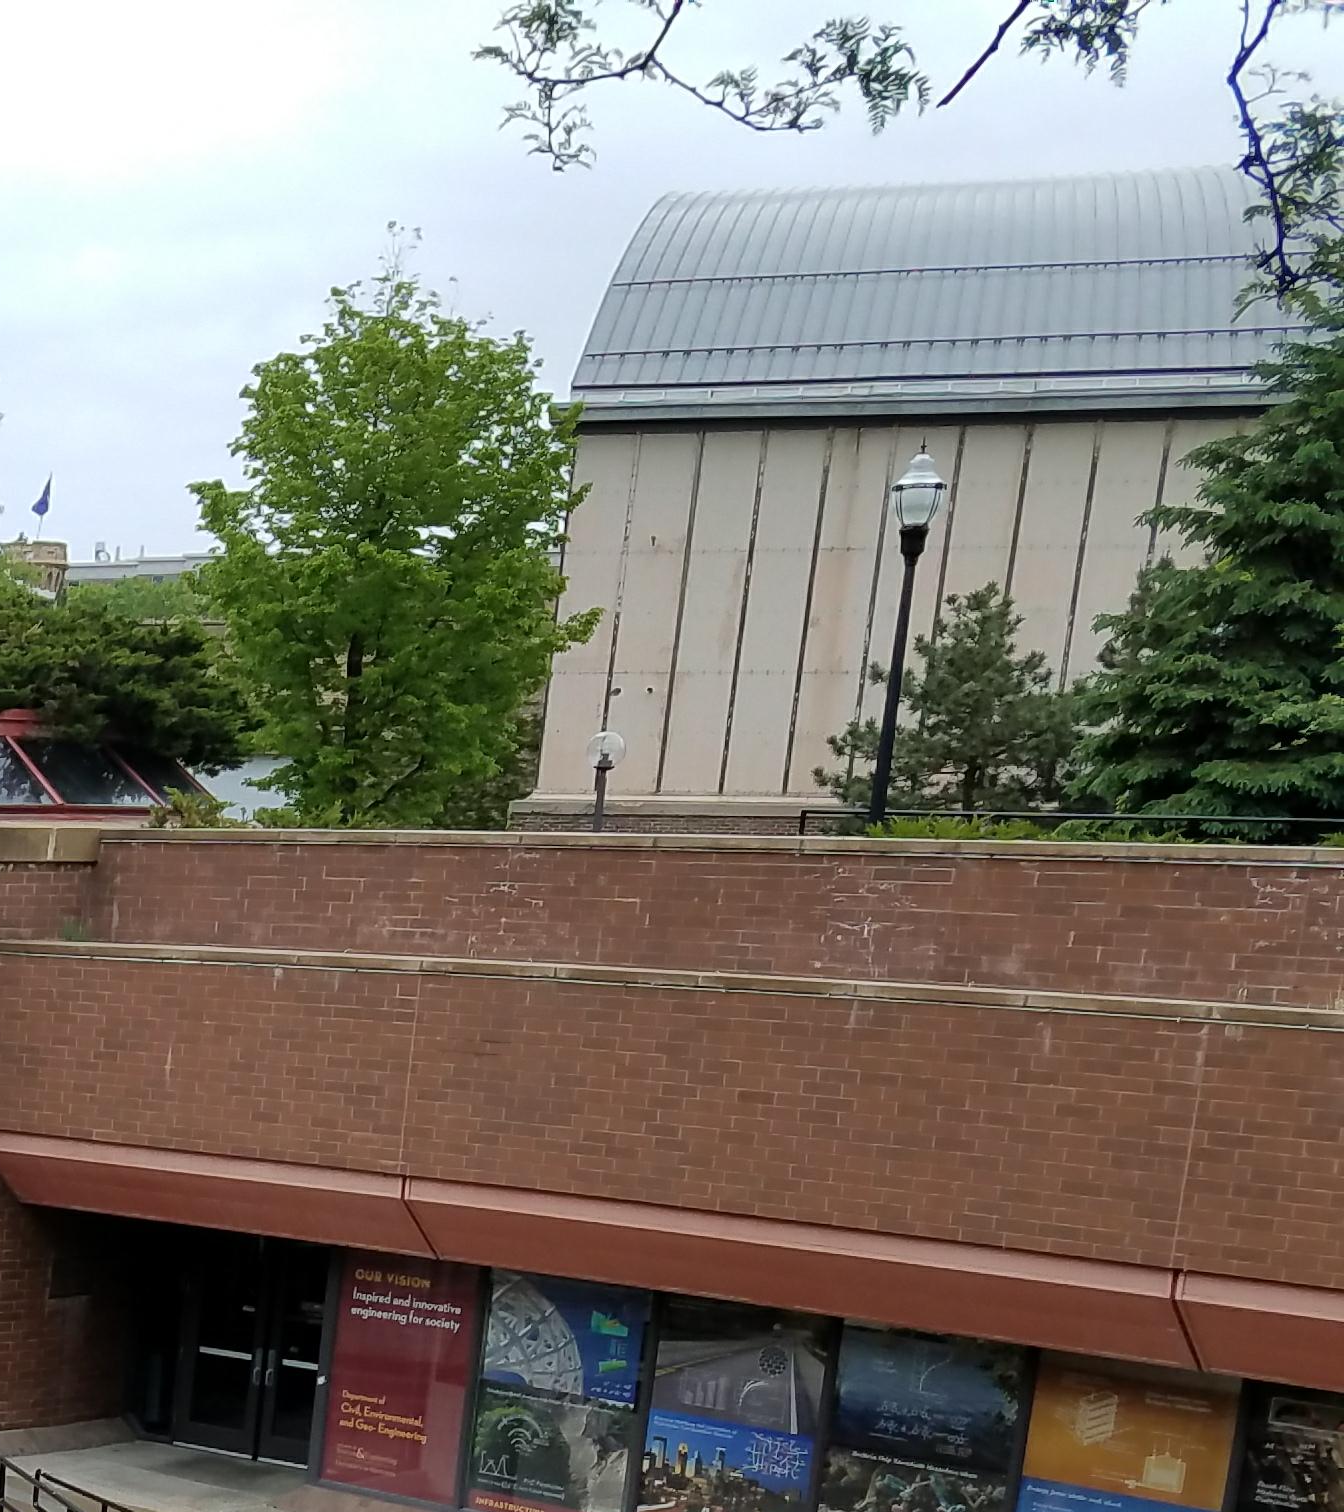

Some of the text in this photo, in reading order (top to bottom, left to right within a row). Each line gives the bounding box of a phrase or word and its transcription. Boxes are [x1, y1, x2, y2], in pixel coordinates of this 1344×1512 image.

[355, 1268, 431, 1289] OUR VISION
[353, 1286, 462, 1315] Inspired and innovative
[351, 1307, 460, 1333] engineering for society
[339, 1417, 354, 1428] and
[378, 1422, 427, 1445] Engineering
